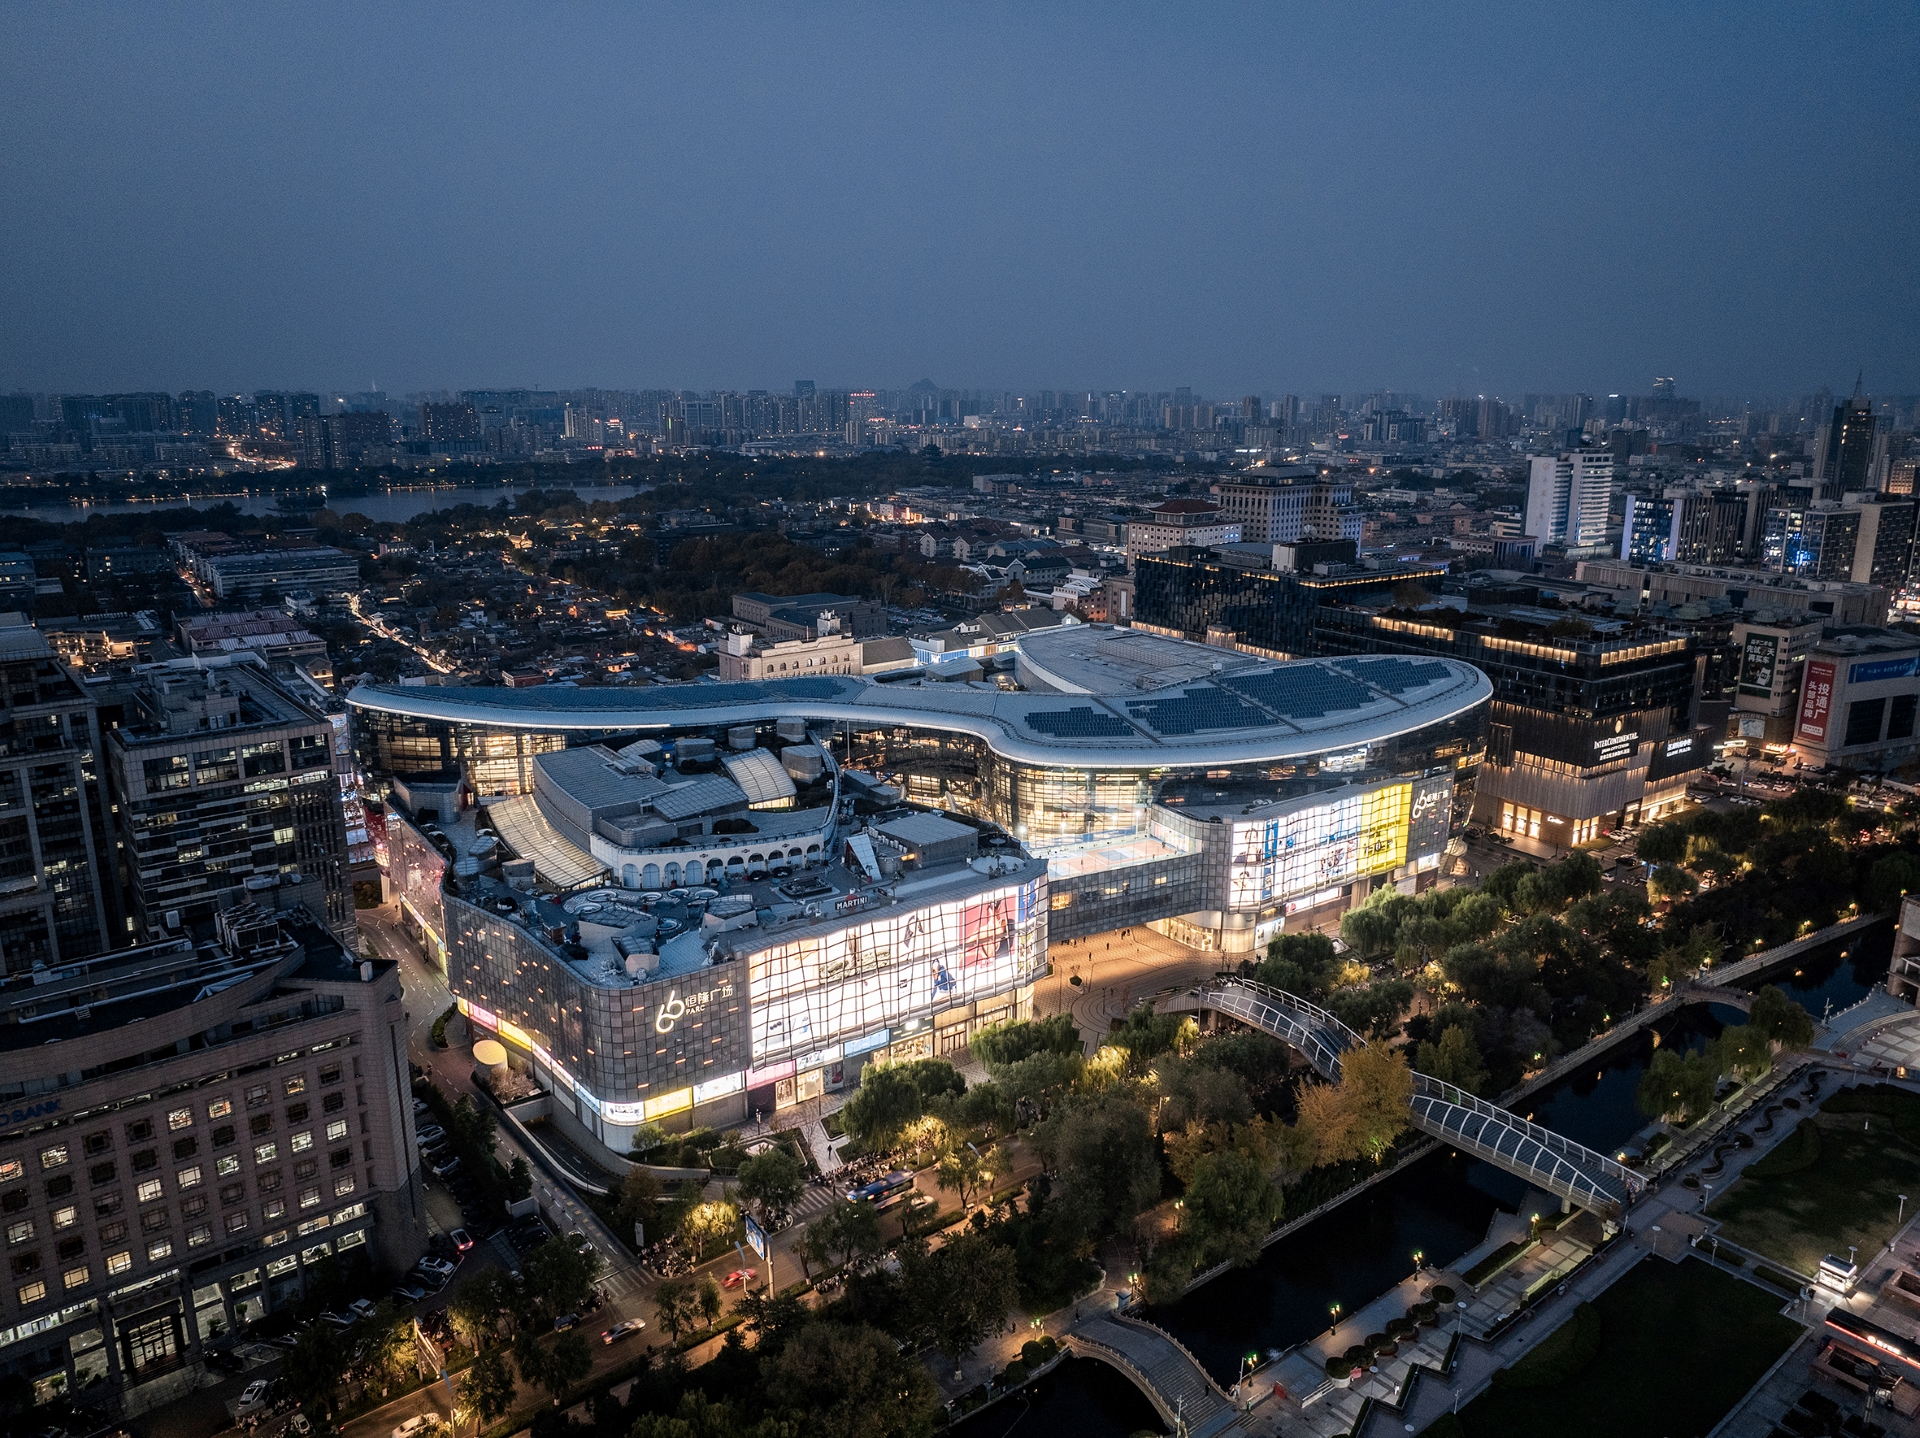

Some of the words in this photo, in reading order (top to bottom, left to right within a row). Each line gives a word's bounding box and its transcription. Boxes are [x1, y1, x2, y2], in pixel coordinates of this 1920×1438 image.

[1803, 681, 1817, 718] 头部品牌
[836, 896, 868, 910] MARTINI
[685, 984, 733, 1008] 恒隆广场
[686, 1004, 706, 1016] PARC
[12, 1099, 62, 1123] BANK
